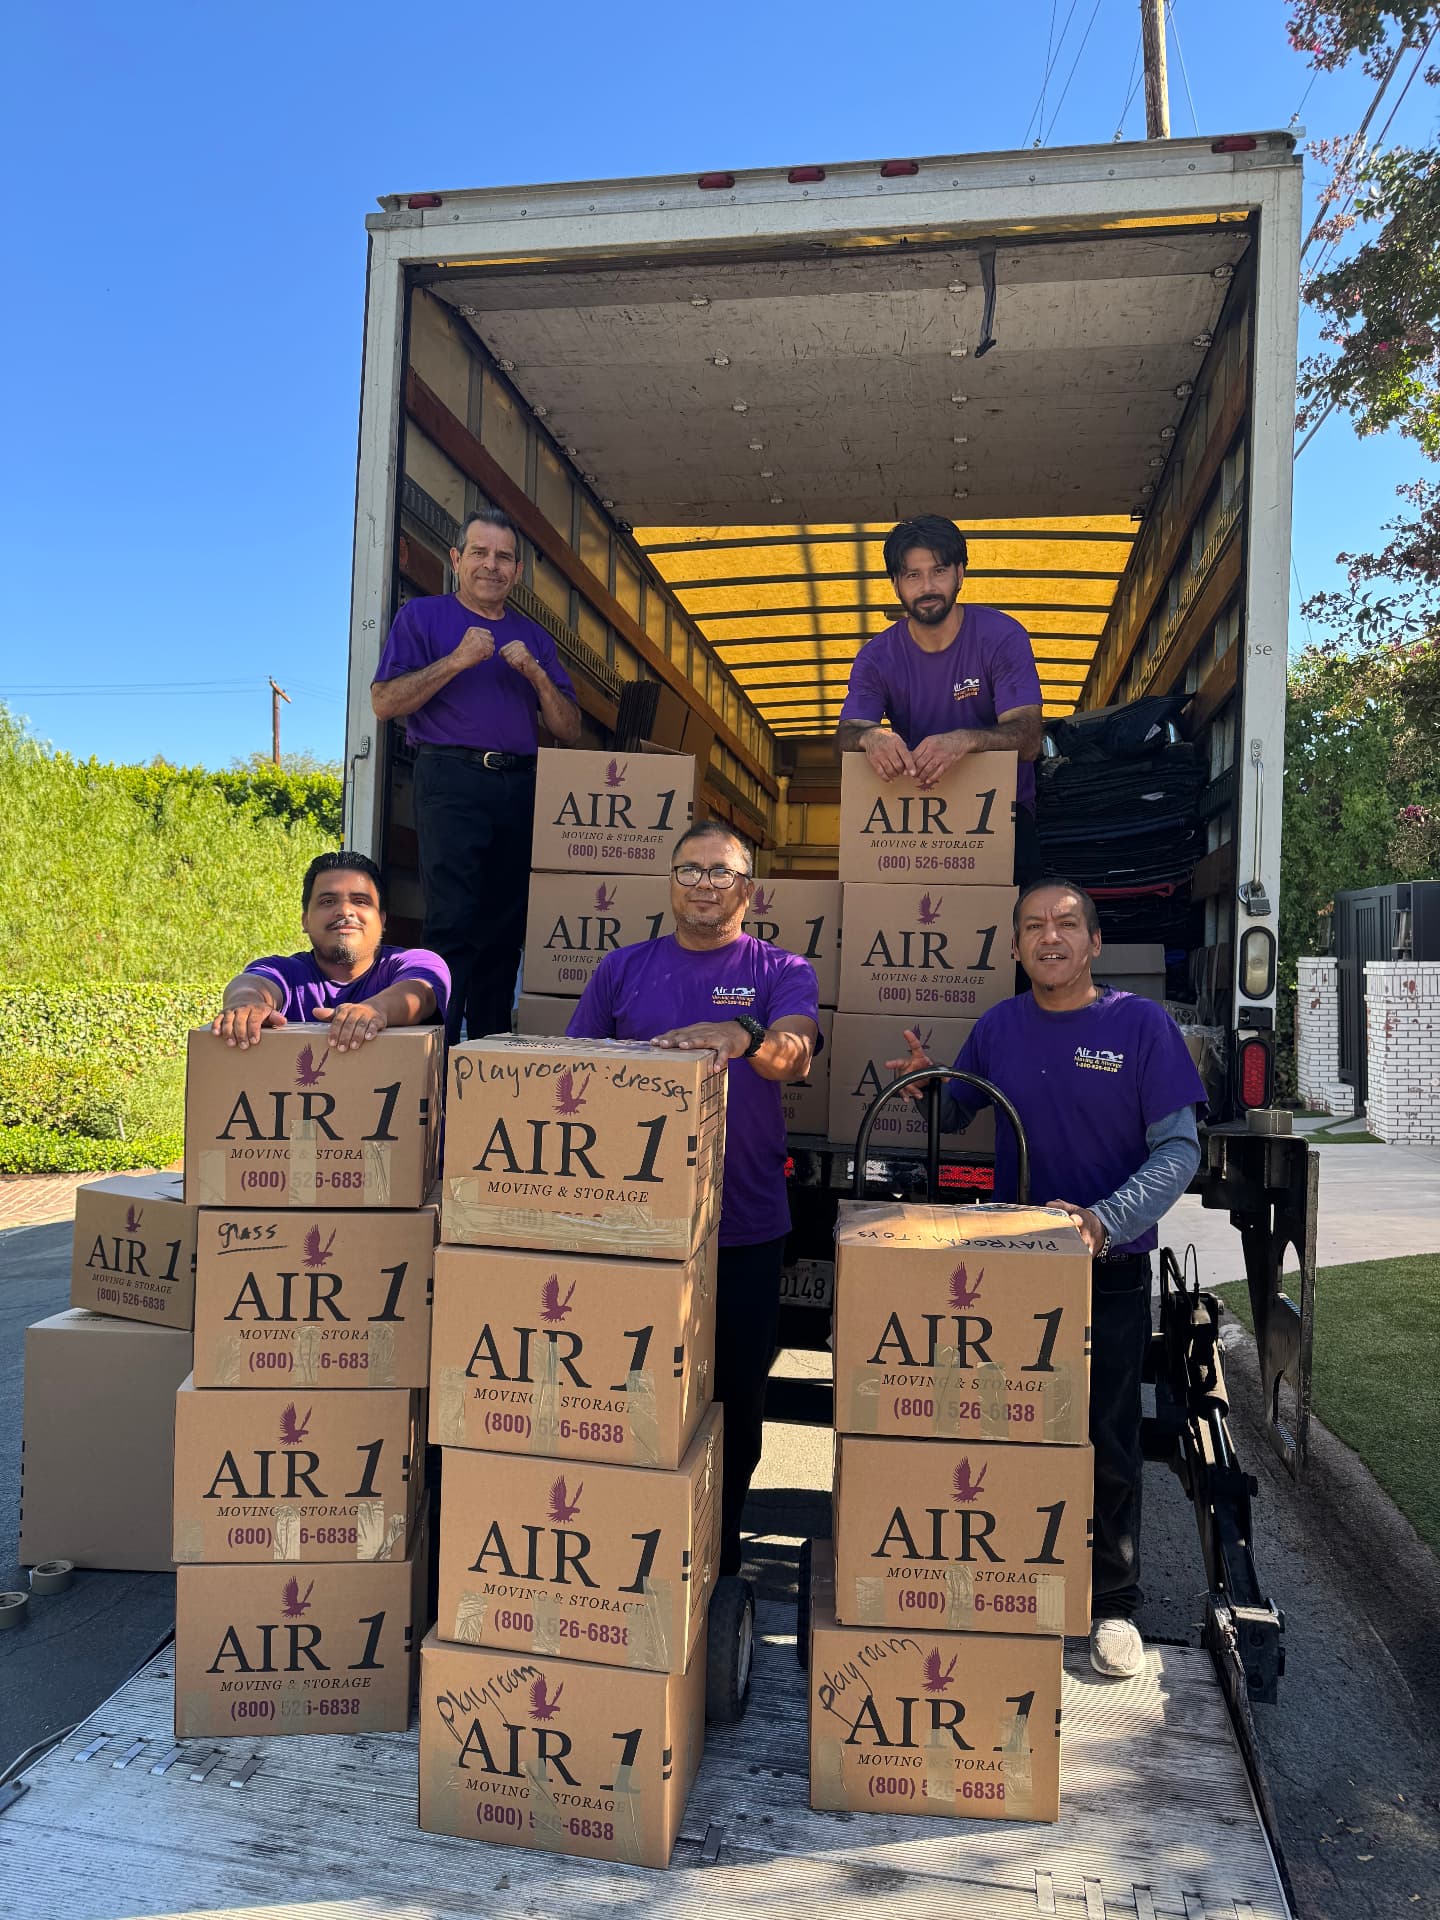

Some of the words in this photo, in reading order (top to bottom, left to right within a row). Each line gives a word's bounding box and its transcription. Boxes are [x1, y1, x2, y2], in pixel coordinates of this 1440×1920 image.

[552, 791, 637, 829] AIR
[647, 789, 676, 831] 1
[860, 796, 954, 835] AIR
[965, 788, 997, 835] 1
[561, 831, 604, 841] MOVING
[606, 834, 615, 842] &
[617, 833, 664, 844] STORAGE
[870, 840, 917, 849] MOVING
[919, 840, 928, 849] &
[931, 840, 985, 849] STORAGE
[568, 843, 598, 859] (800)
[601, 846, 656, 860] 526-6838
[878, 855, 911, 872] (800)
[915, 856, 976, 870] 526-6838
[543, 915, 622, 951] AIR
[803, 915, 825, 959] 1
[552, 954, 594, 964] MOVING
[860, 929, 955, 970] AIR
[966, 924, 998, 971] 1
[558, 967, 587, 983] (800)
[871, 972, 917, 983] MOVING
[920, 975, 928, 983] &
[931, 974, 985, 985] STORAGE
[878, 986, 911, 1004] (800)
[915, 988, 976, 1004] 526-6838
[215, 1090, 344, 1141] AIR
[361, 1081, 402, 1141] 1
[472, 1117, 605, 1179] AIR
[623, 1114, 667, 1183] 1
[240, 1170, 287, 1192] (800)
[487, 1181, 553, 1197] MOVING
[558, 1188, 569, 1198] &
[574, 1187, 649, 1203] STORAGE
[85, 1234, 151, 1277] AIR
[158, 1239, 182, 1282] 1
[92, 1273, 125, 1286] MOVING
[134, 1280, 173, 1294] STORAGE
[223, 1271, 351, 1322] AIR
[367, 1261, 408, 1322] 1
[97, 1287, 121, 1305] (800)
[122, 1292, 165, 1311] 526-6838
[867, 1311, 993, 1369] AIR
[1021, 1307, 1064, 1372] 1
[249, 1352, 294, 1372] (800)
[465, 1323, 593, 1389] AIR
[610, 1325, 655, 1393] 1
[484, 1411, 532, 1438] (800)
[202, 1449, 329, 1499] AIR
[344, 1438, 384, 1498] 1
[300, 1505, 359, 1517] STORAG
[227, 1527, 272, 1548] (800)
[870, 1506, 1006, 1563] AIR
[1024, 1500, 1066, 1565] 1
[467, 1520, 601, 1588] AIR
[618, 1528, 662, 1595] 1
[898, 1590, 946, 1613] (800)
[205, 1624, 331, 1673] AIR
[347, 1610, 386, 1670] 1
[219, 1679, 283, 1692] MOVING
[302, 1677, 372, 1689] STORAGE
[230, 1700, 276, 1721] (800)
[844, 1695, 976, 1750] AIR
[992, 1690, 1035, 1753] 1
[458, 1718, 581, 1787] AIR
[600, 1728, 643, 1793] 1
[857, 1754, 923, 1767] MOVING
[465, 1778, 530, 1799] MOVING
[868, 1776, 916, 1800] (800)
[476, 1801, 523, 1830] (800)
